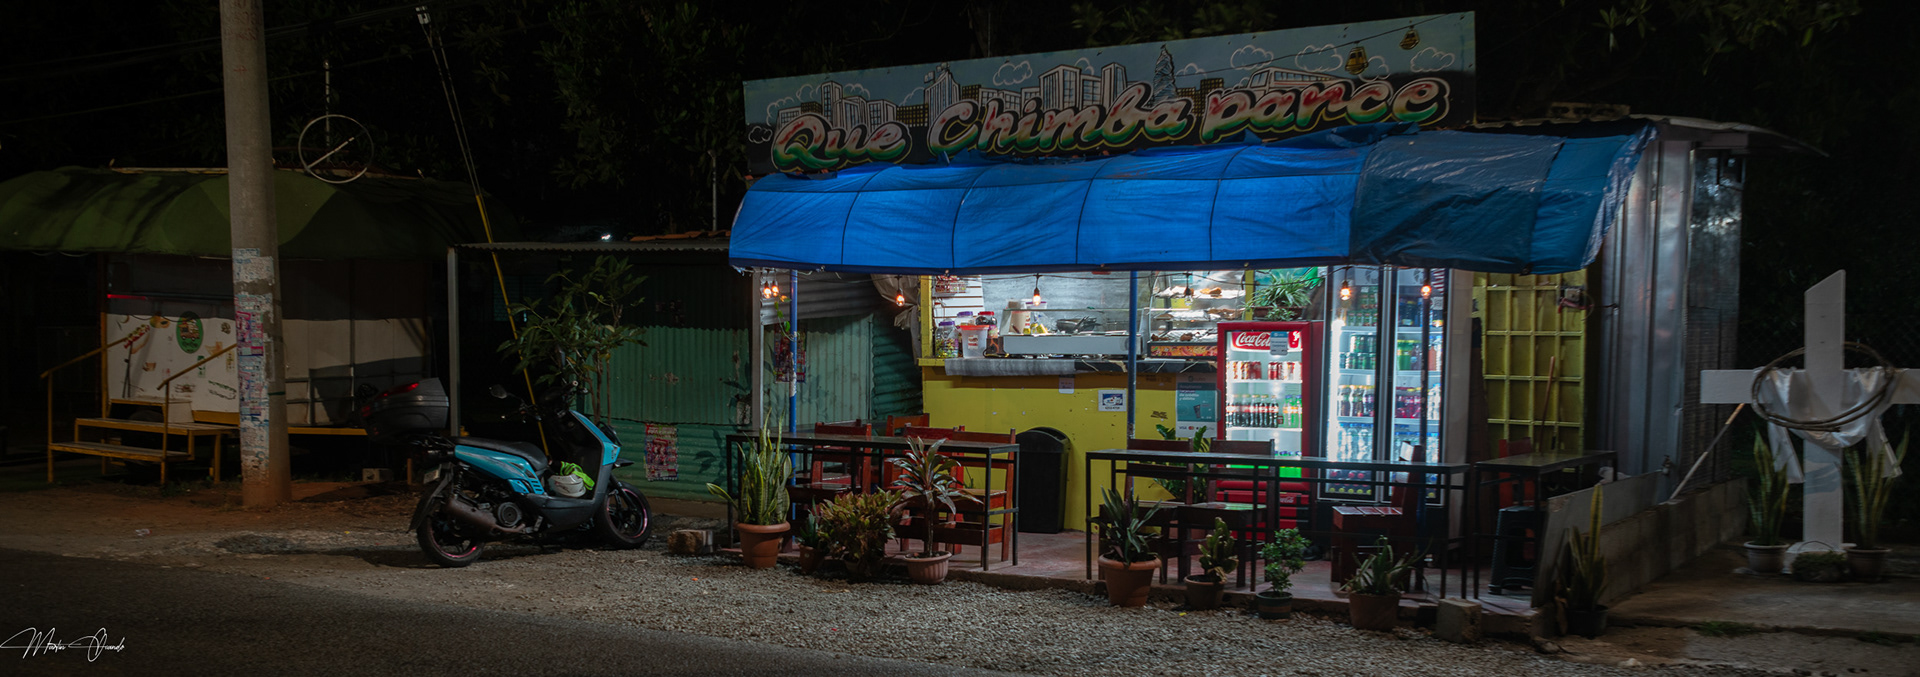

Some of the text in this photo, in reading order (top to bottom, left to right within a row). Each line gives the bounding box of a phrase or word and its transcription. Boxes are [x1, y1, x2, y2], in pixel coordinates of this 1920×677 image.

[771, 77, 1447, 170] Que Chimba parce
[1236, 331, 1271, 347] Coca-Col
